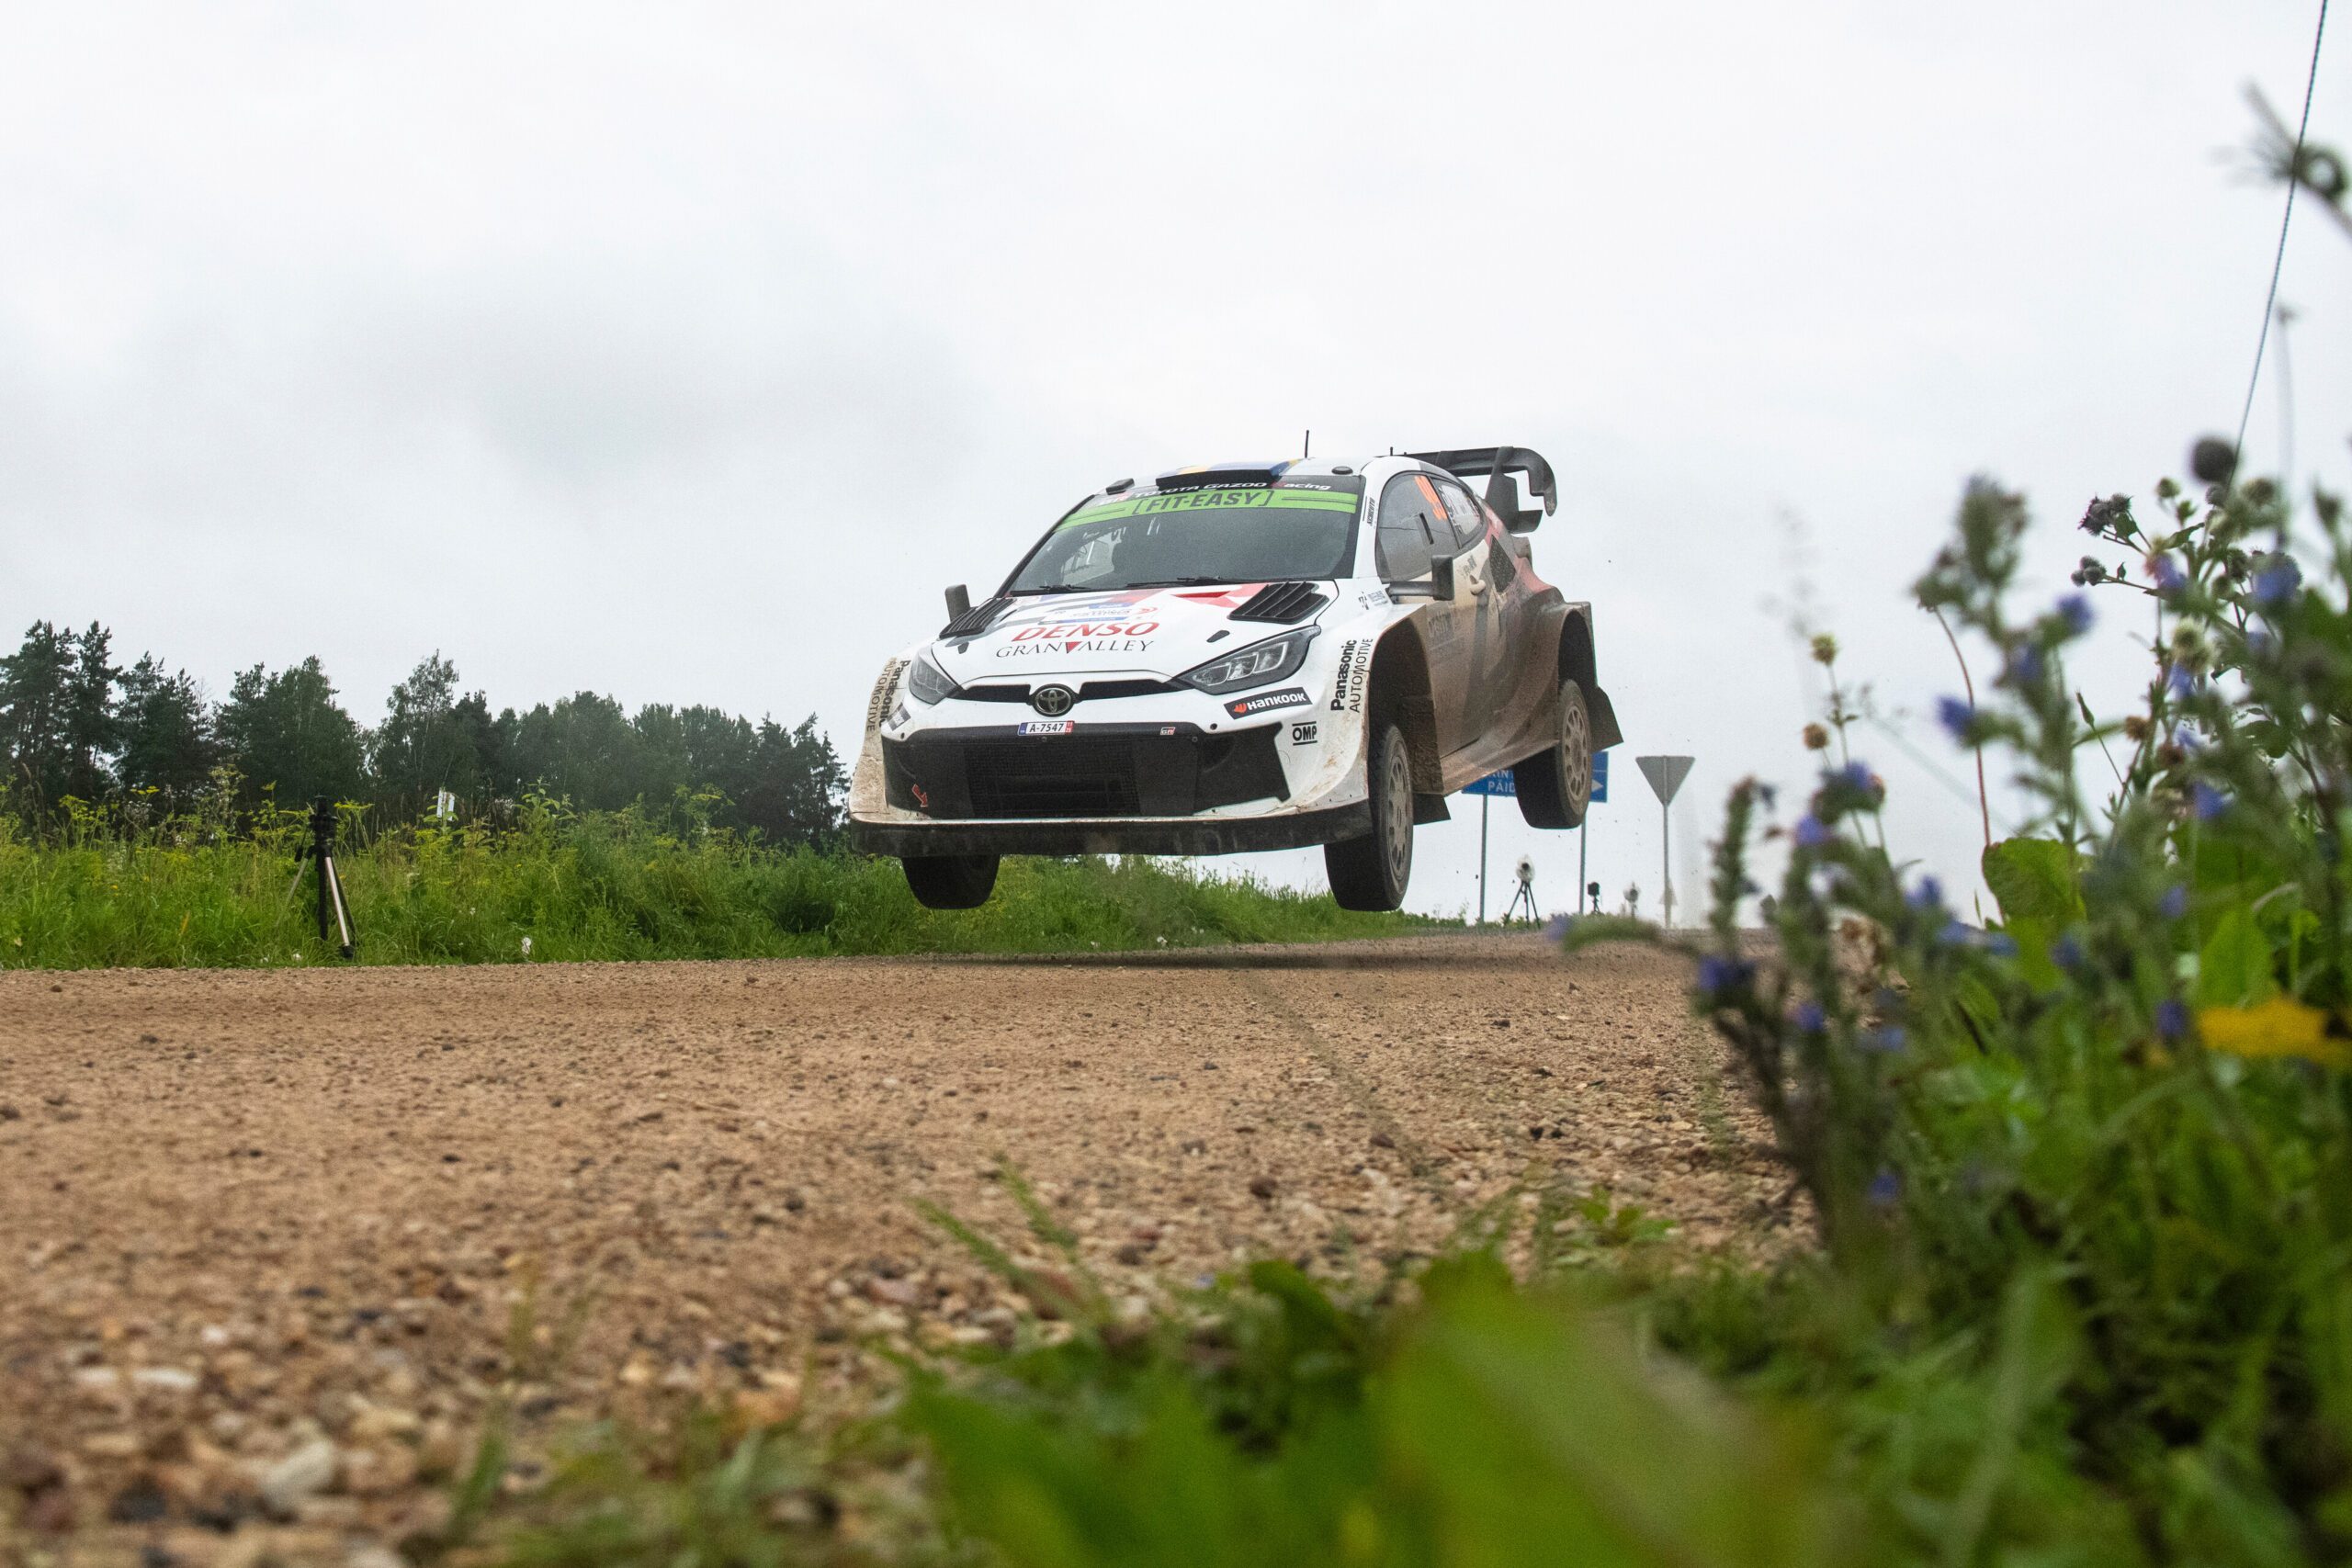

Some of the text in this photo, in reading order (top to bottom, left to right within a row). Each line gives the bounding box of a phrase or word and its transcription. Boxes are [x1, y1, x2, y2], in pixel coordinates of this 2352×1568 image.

[1136, 485, 1200, 498] TOYOTA
[1270, 481, 1331, 491] Racing
[1012, 622, 1160, 642] DENSO
[866, 658, 897, 732] AUTOMOTIVE
[878, 660, 912, 728] Panasonic
[1330, 639, 1357, 712] Panasonic
[1349, 638, 1374, 714] AUTOMOTIVE
[1029, 723, 1064, 732] A-7547
[1292, 725, 1317, 741] OMP
